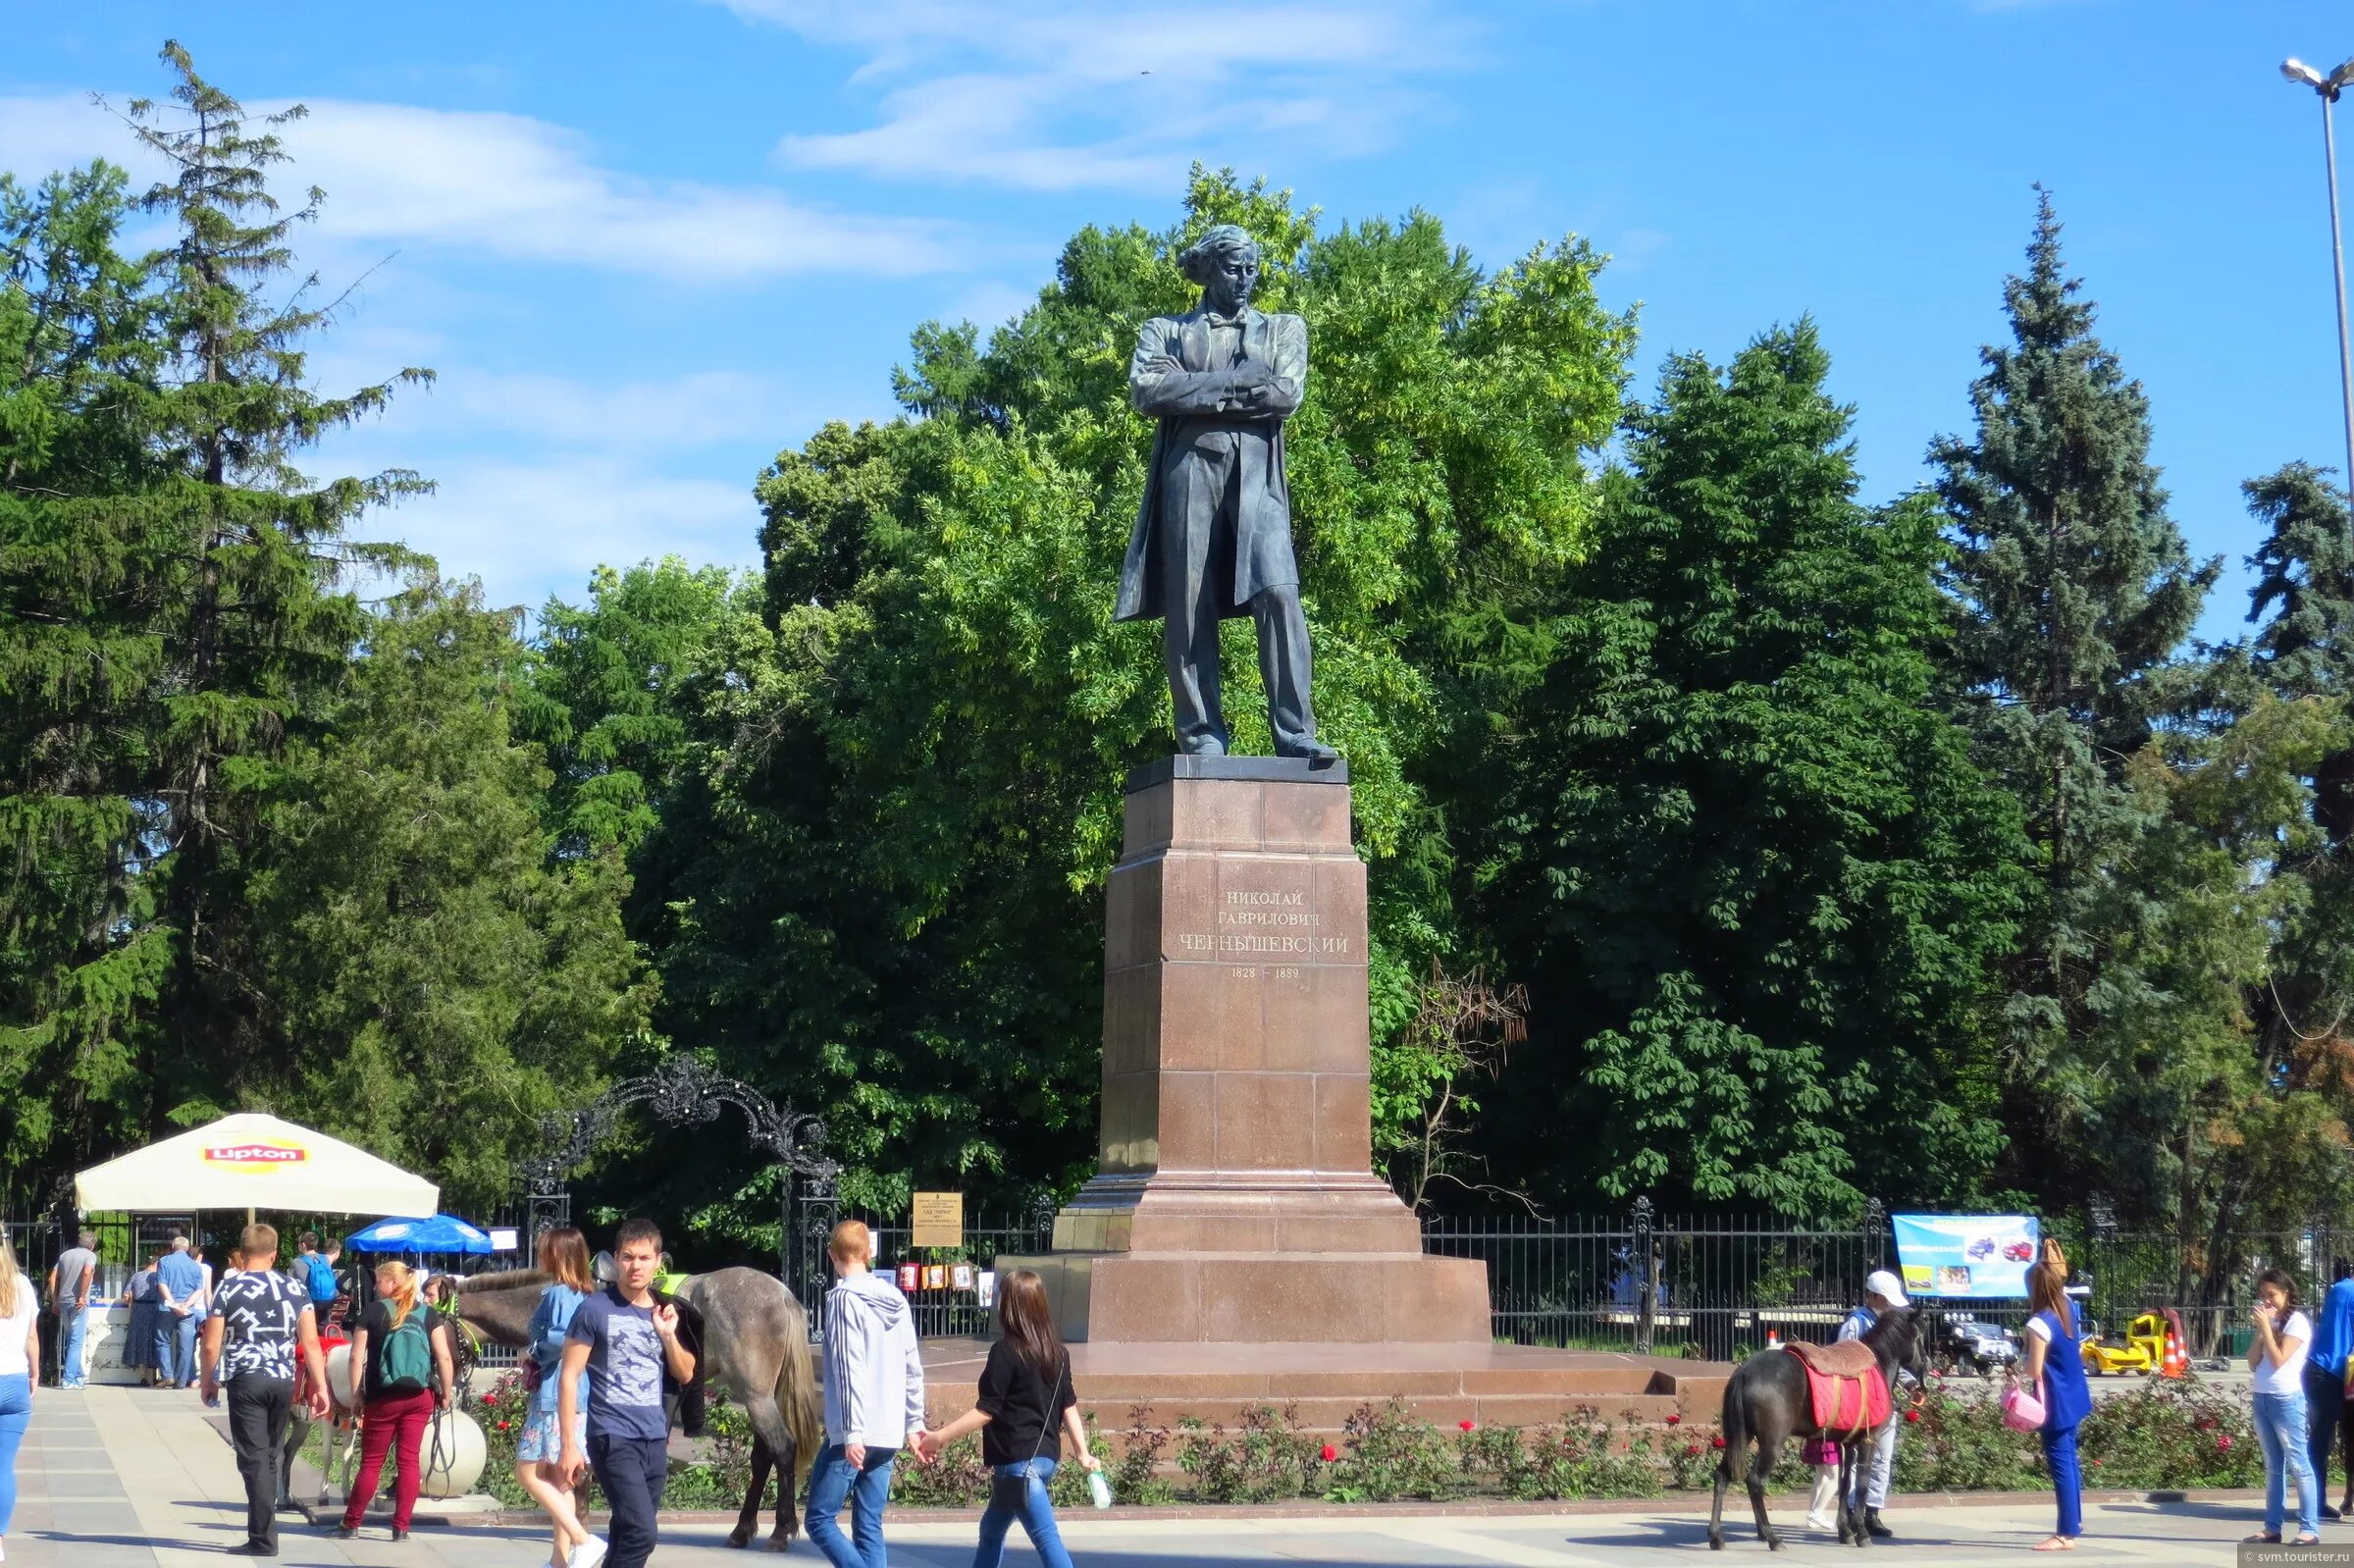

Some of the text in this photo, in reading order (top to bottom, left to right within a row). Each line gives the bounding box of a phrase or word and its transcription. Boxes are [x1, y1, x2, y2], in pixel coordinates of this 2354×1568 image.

[1227, 889, 1303, 905] НИКОЛАЙ
[1218, 913, 1320, 925] ГАВРИЛОВИЧ
[1179, 933, 1349, 953] ЧЕРНЫШЕВСКИЙ
[1231, 967, 1256, 977] 1828
[1276, 967, 1299, 978] 1889
[213, 1148, 296, 1160] Lipton
